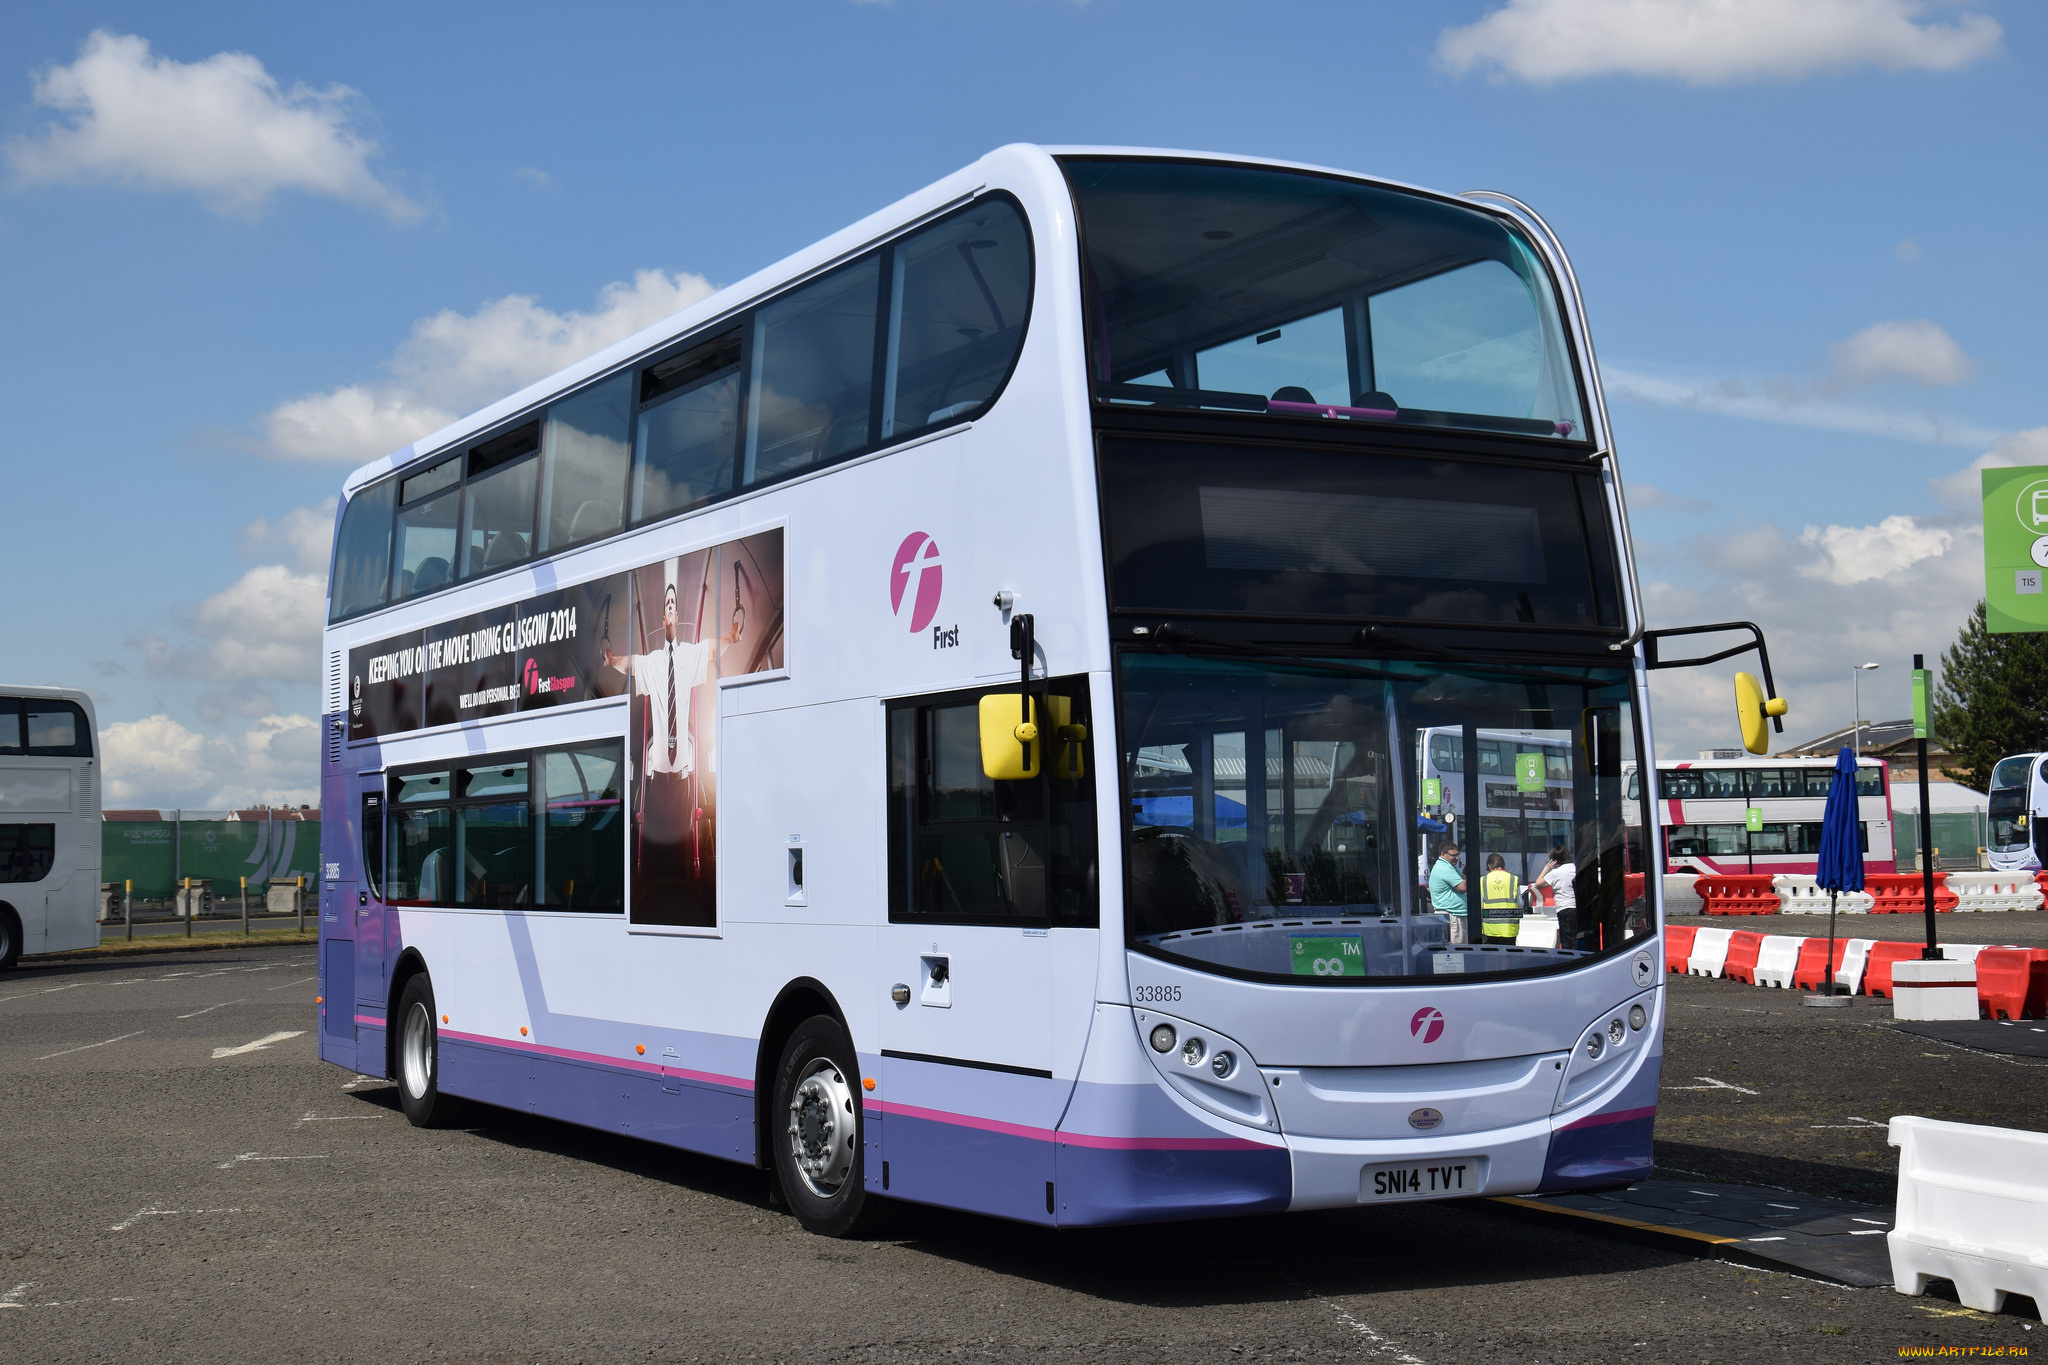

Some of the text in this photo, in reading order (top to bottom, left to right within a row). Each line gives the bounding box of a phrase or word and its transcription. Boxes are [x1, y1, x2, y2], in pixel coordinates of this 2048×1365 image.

[2022, 578, 2035, 587] TIS
[368, 606, 576, 684] KEEPING YOU ON THE MOVE DURING GLASGOW 2014
[934, 624, 959, 649] First
[473, 691, 479, 707] DO
[487, 686, 509, 704] PERSONAL
[510, 683, 521, 701] BEST
[326, 863, 339, 879] 33885
[1341, 942, 1361, 955] TM
[1136, 986, 1181, 1001] 33885
[1374, 1165, 1466, 1195] SN14 TVT
